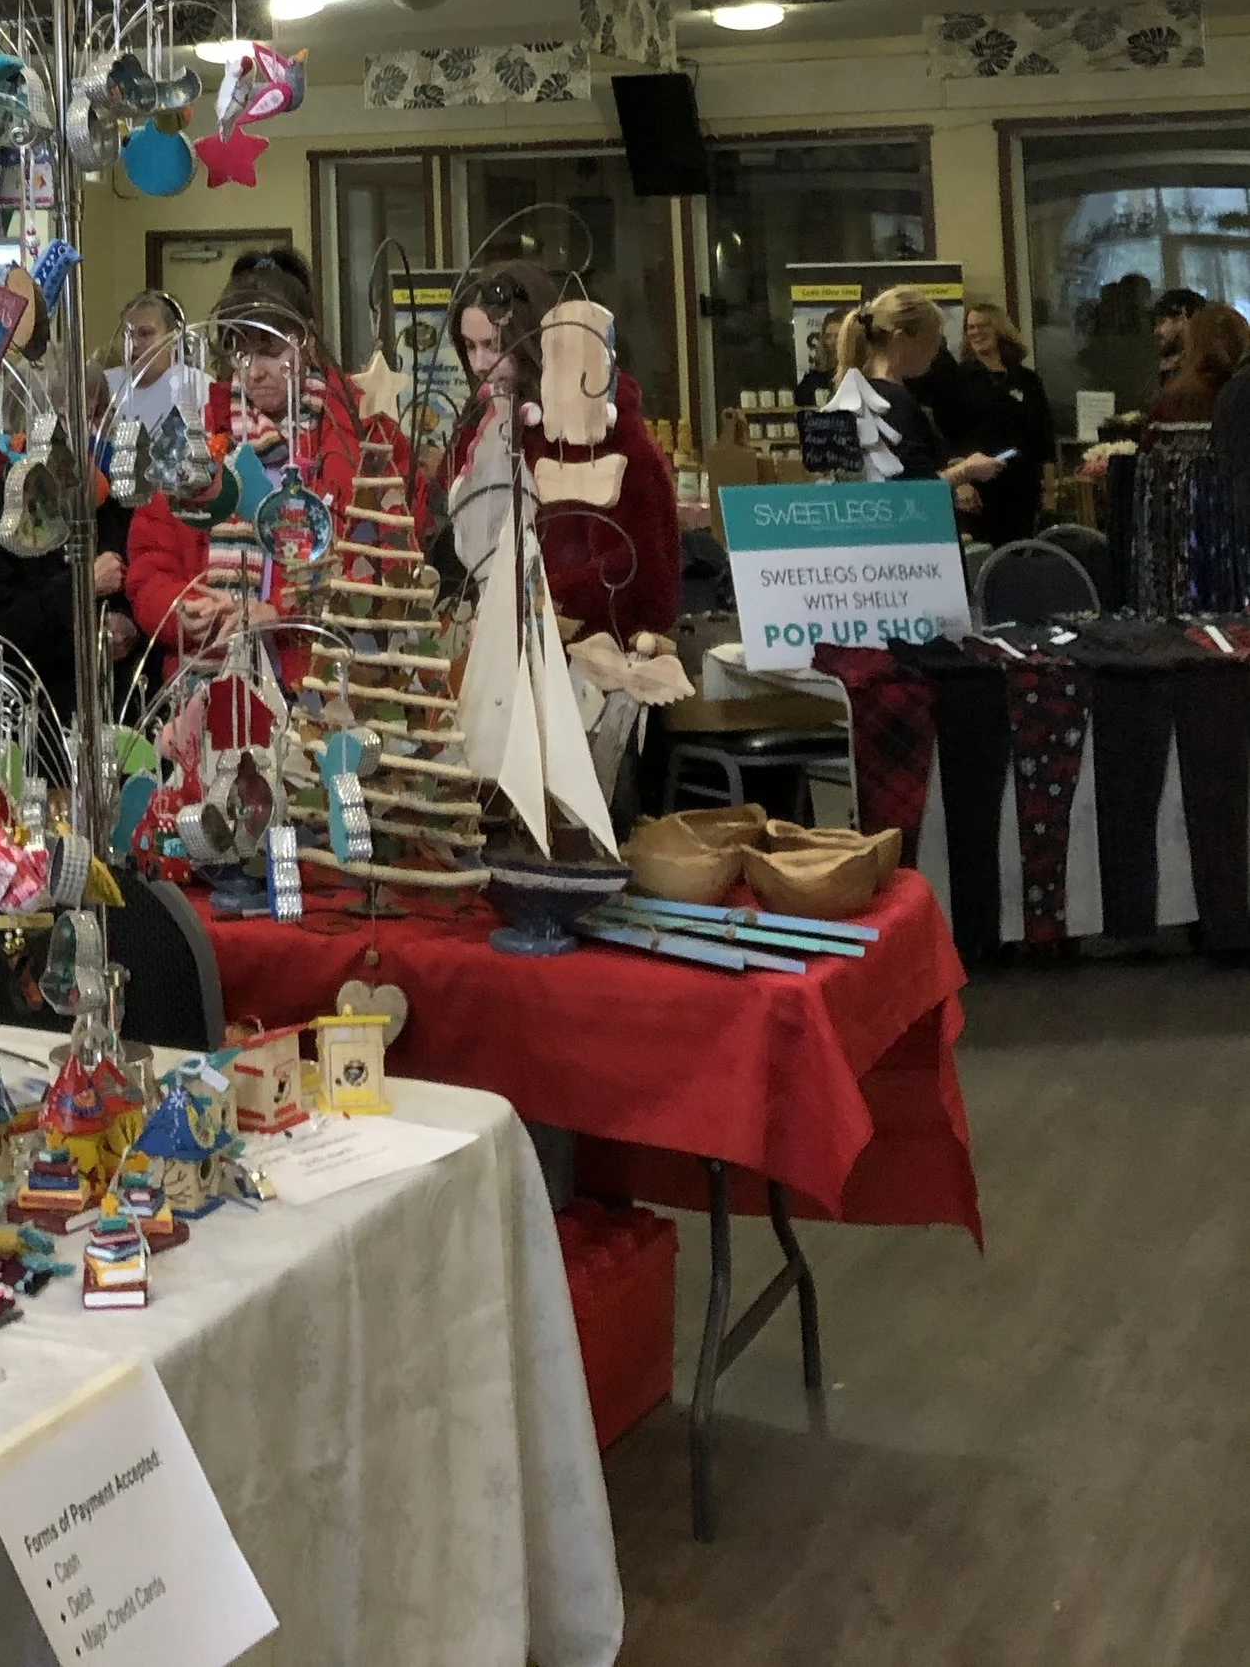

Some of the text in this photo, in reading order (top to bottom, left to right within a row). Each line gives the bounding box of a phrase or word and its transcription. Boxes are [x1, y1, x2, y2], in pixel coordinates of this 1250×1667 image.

[754, 499, 893, 527] SWEETLEGS
[760, 563, 942, 588] SWEETLEGS OAKBANK
[803, 590, 909, 611] WITH SHELLY
[764, 616, 935, 648] POP UP SHO
[24, 1523, 59, 1558] Forms
[58, 1508, 72, 1534] of
[69, 1481, 116, 1526] Payment
[53, 1553, 81, 1584] Cash
[66, 1586, 95, 1619] Debit
[106, 1595, 138, 1631] Credit
[134, 1576, 166, 1611] Cards
